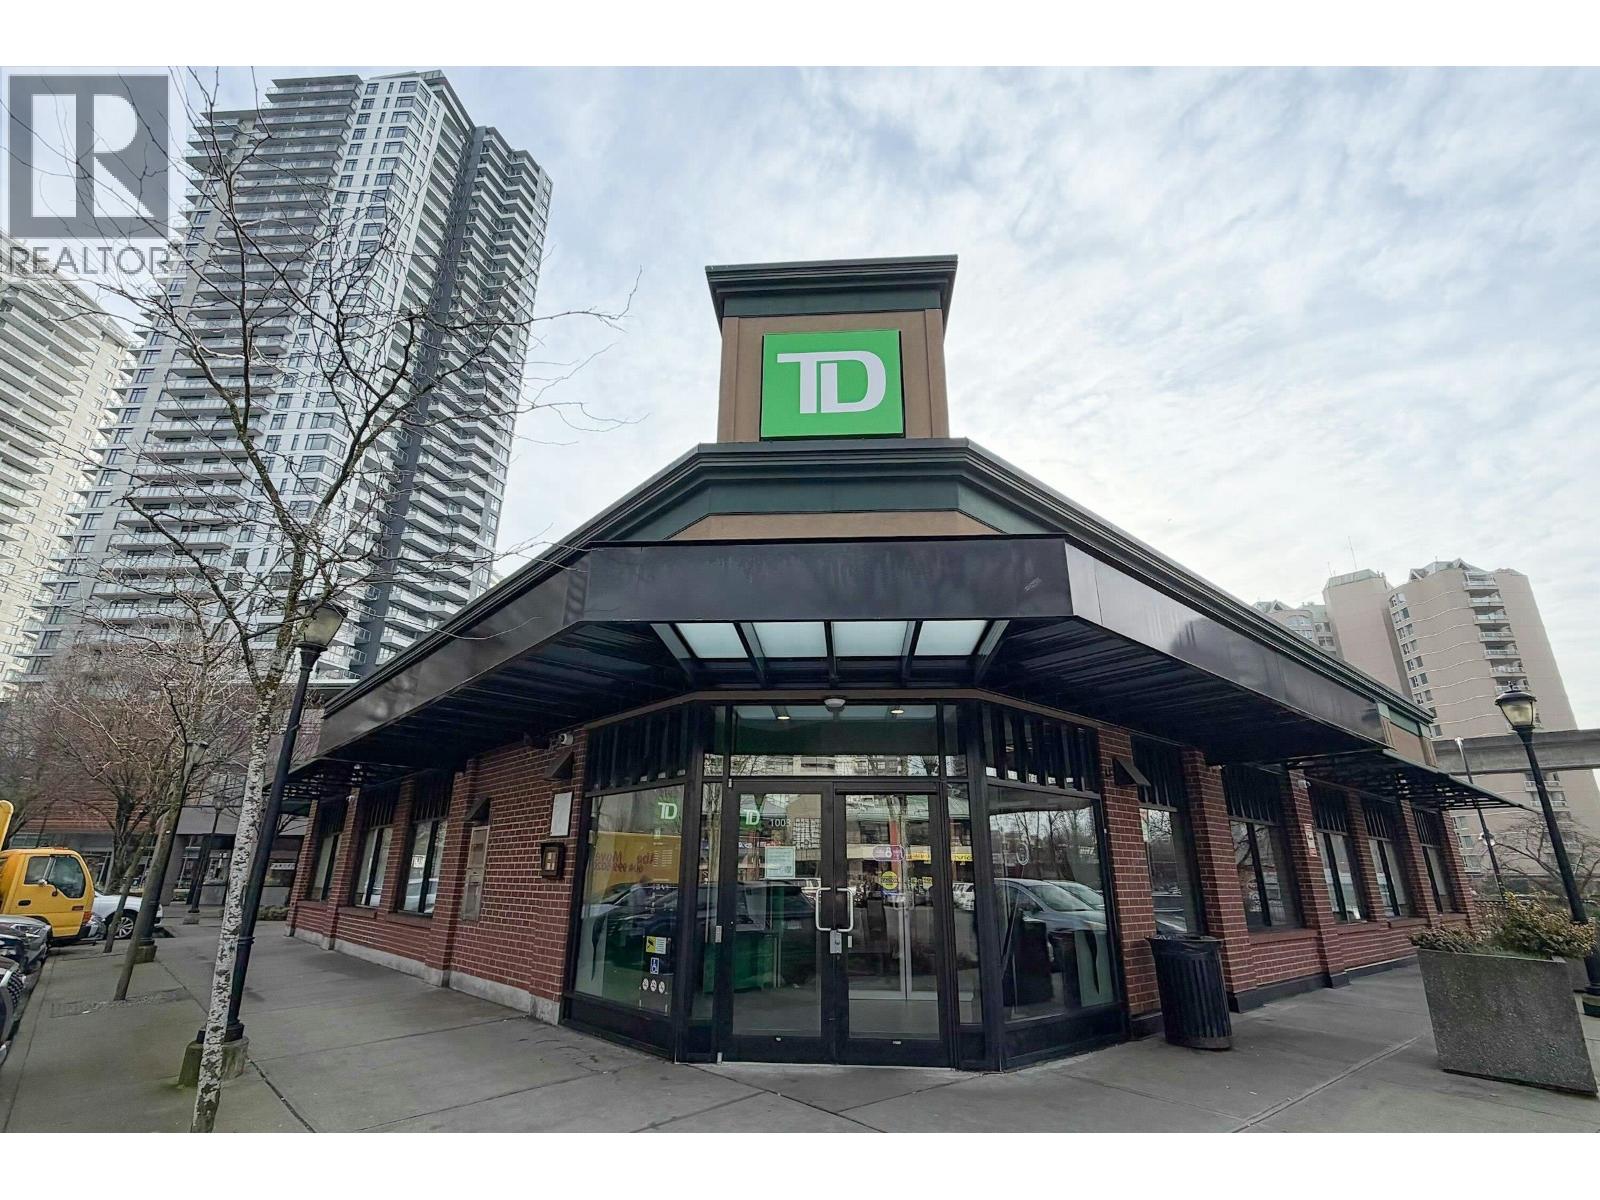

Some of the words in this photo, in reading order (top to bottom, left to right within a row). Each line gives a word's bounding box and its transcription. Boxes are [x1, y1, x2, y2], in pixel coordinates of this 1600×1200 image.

[776, 350, 887, 414] TD
[657, 801, 678, 820] TD
[743, 808, 761, 826] TD
[770, 818, 792, 828] 1003
